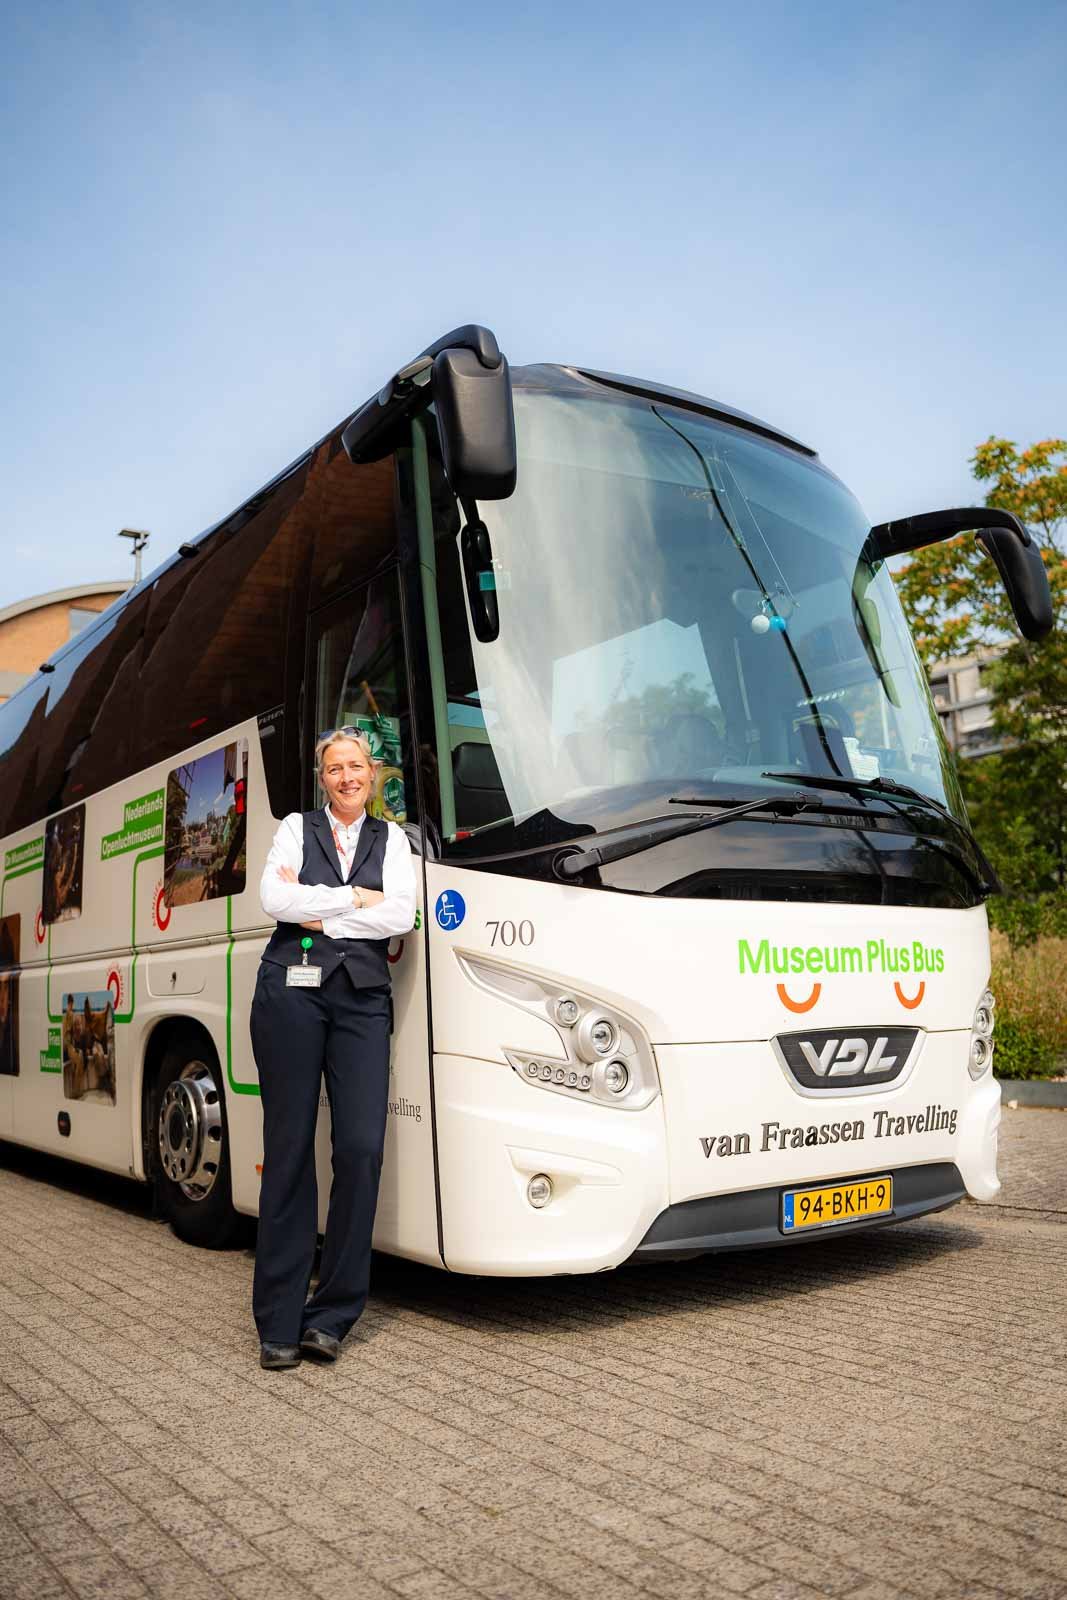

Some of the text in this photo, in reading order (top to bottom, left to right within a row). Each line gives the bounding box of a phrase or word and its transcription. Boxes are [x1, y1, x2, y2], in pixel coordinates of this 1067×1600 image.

[125, 793, 164, 823] Nederlands
[103, 824, 162, 857] Openluchtmuseum
[485, 919, 535, 947] 700
[798, 1036, 898, 1077] VDL
[387, 1097, 422, 1123] velling
[699, 1104, 958, 1159] van Fraassen Travelling
[799, 1184, 886, 1221] 94-BKH-9
